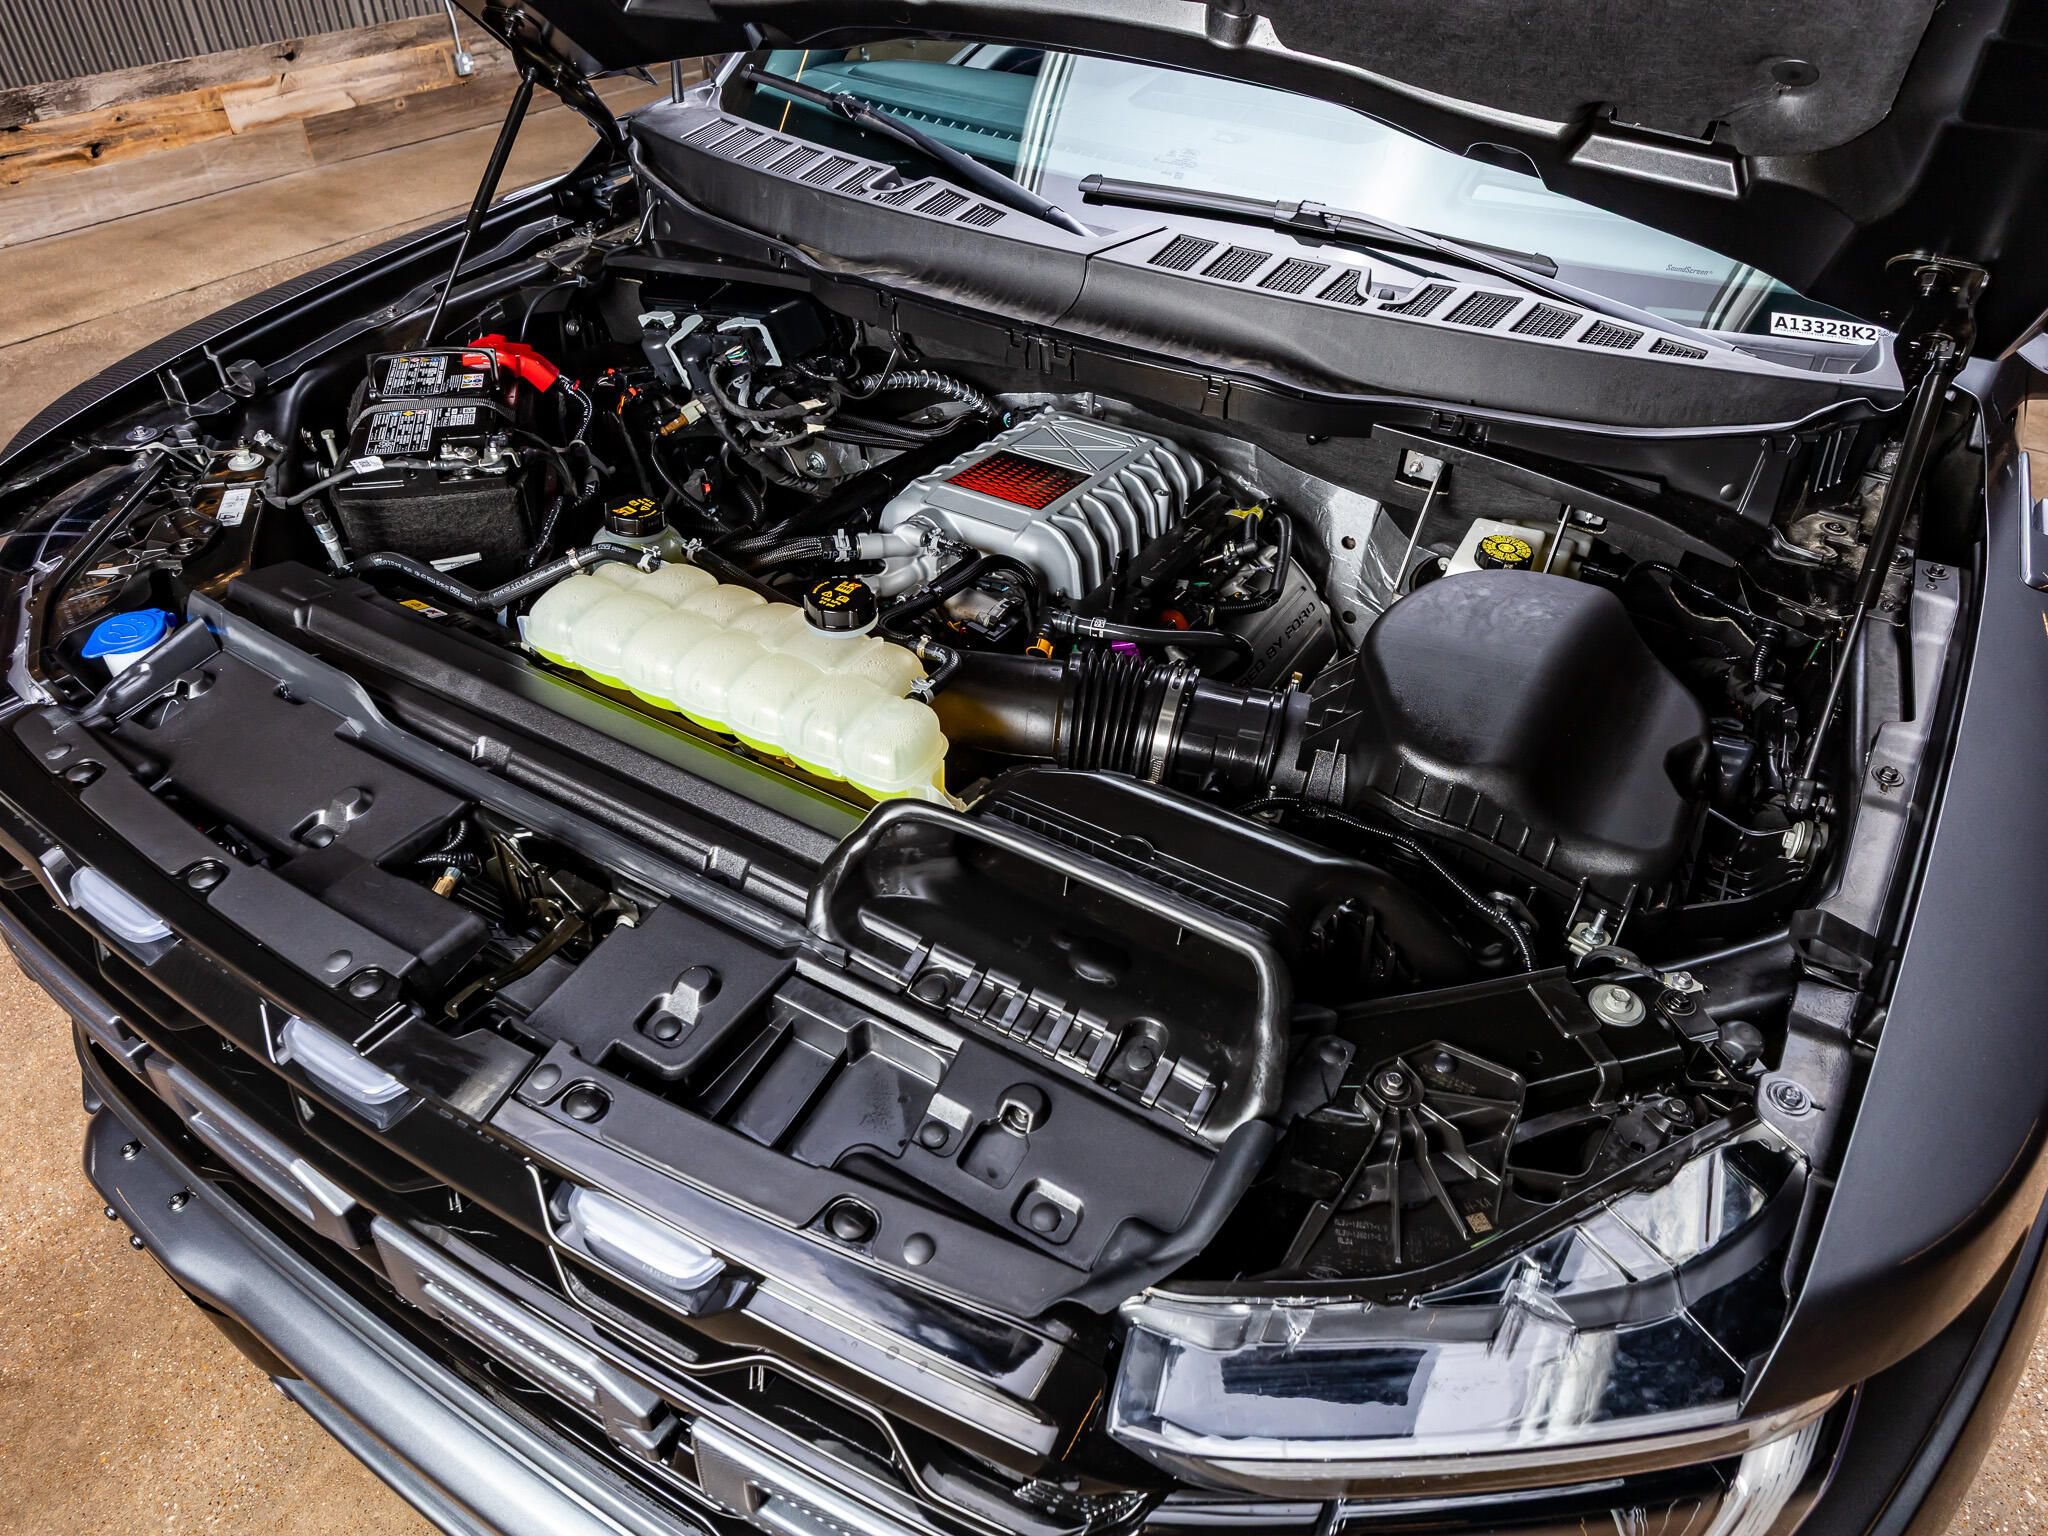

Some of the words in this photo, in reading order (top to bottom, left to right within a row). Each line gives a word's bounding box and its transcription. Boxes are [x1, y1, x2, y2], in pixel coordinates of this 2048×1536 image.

[1774, 315, 1877, 341] A13328K2
[1266, 637, 1283, 659] BY
[1285, 602, 1316, 639] FORD
